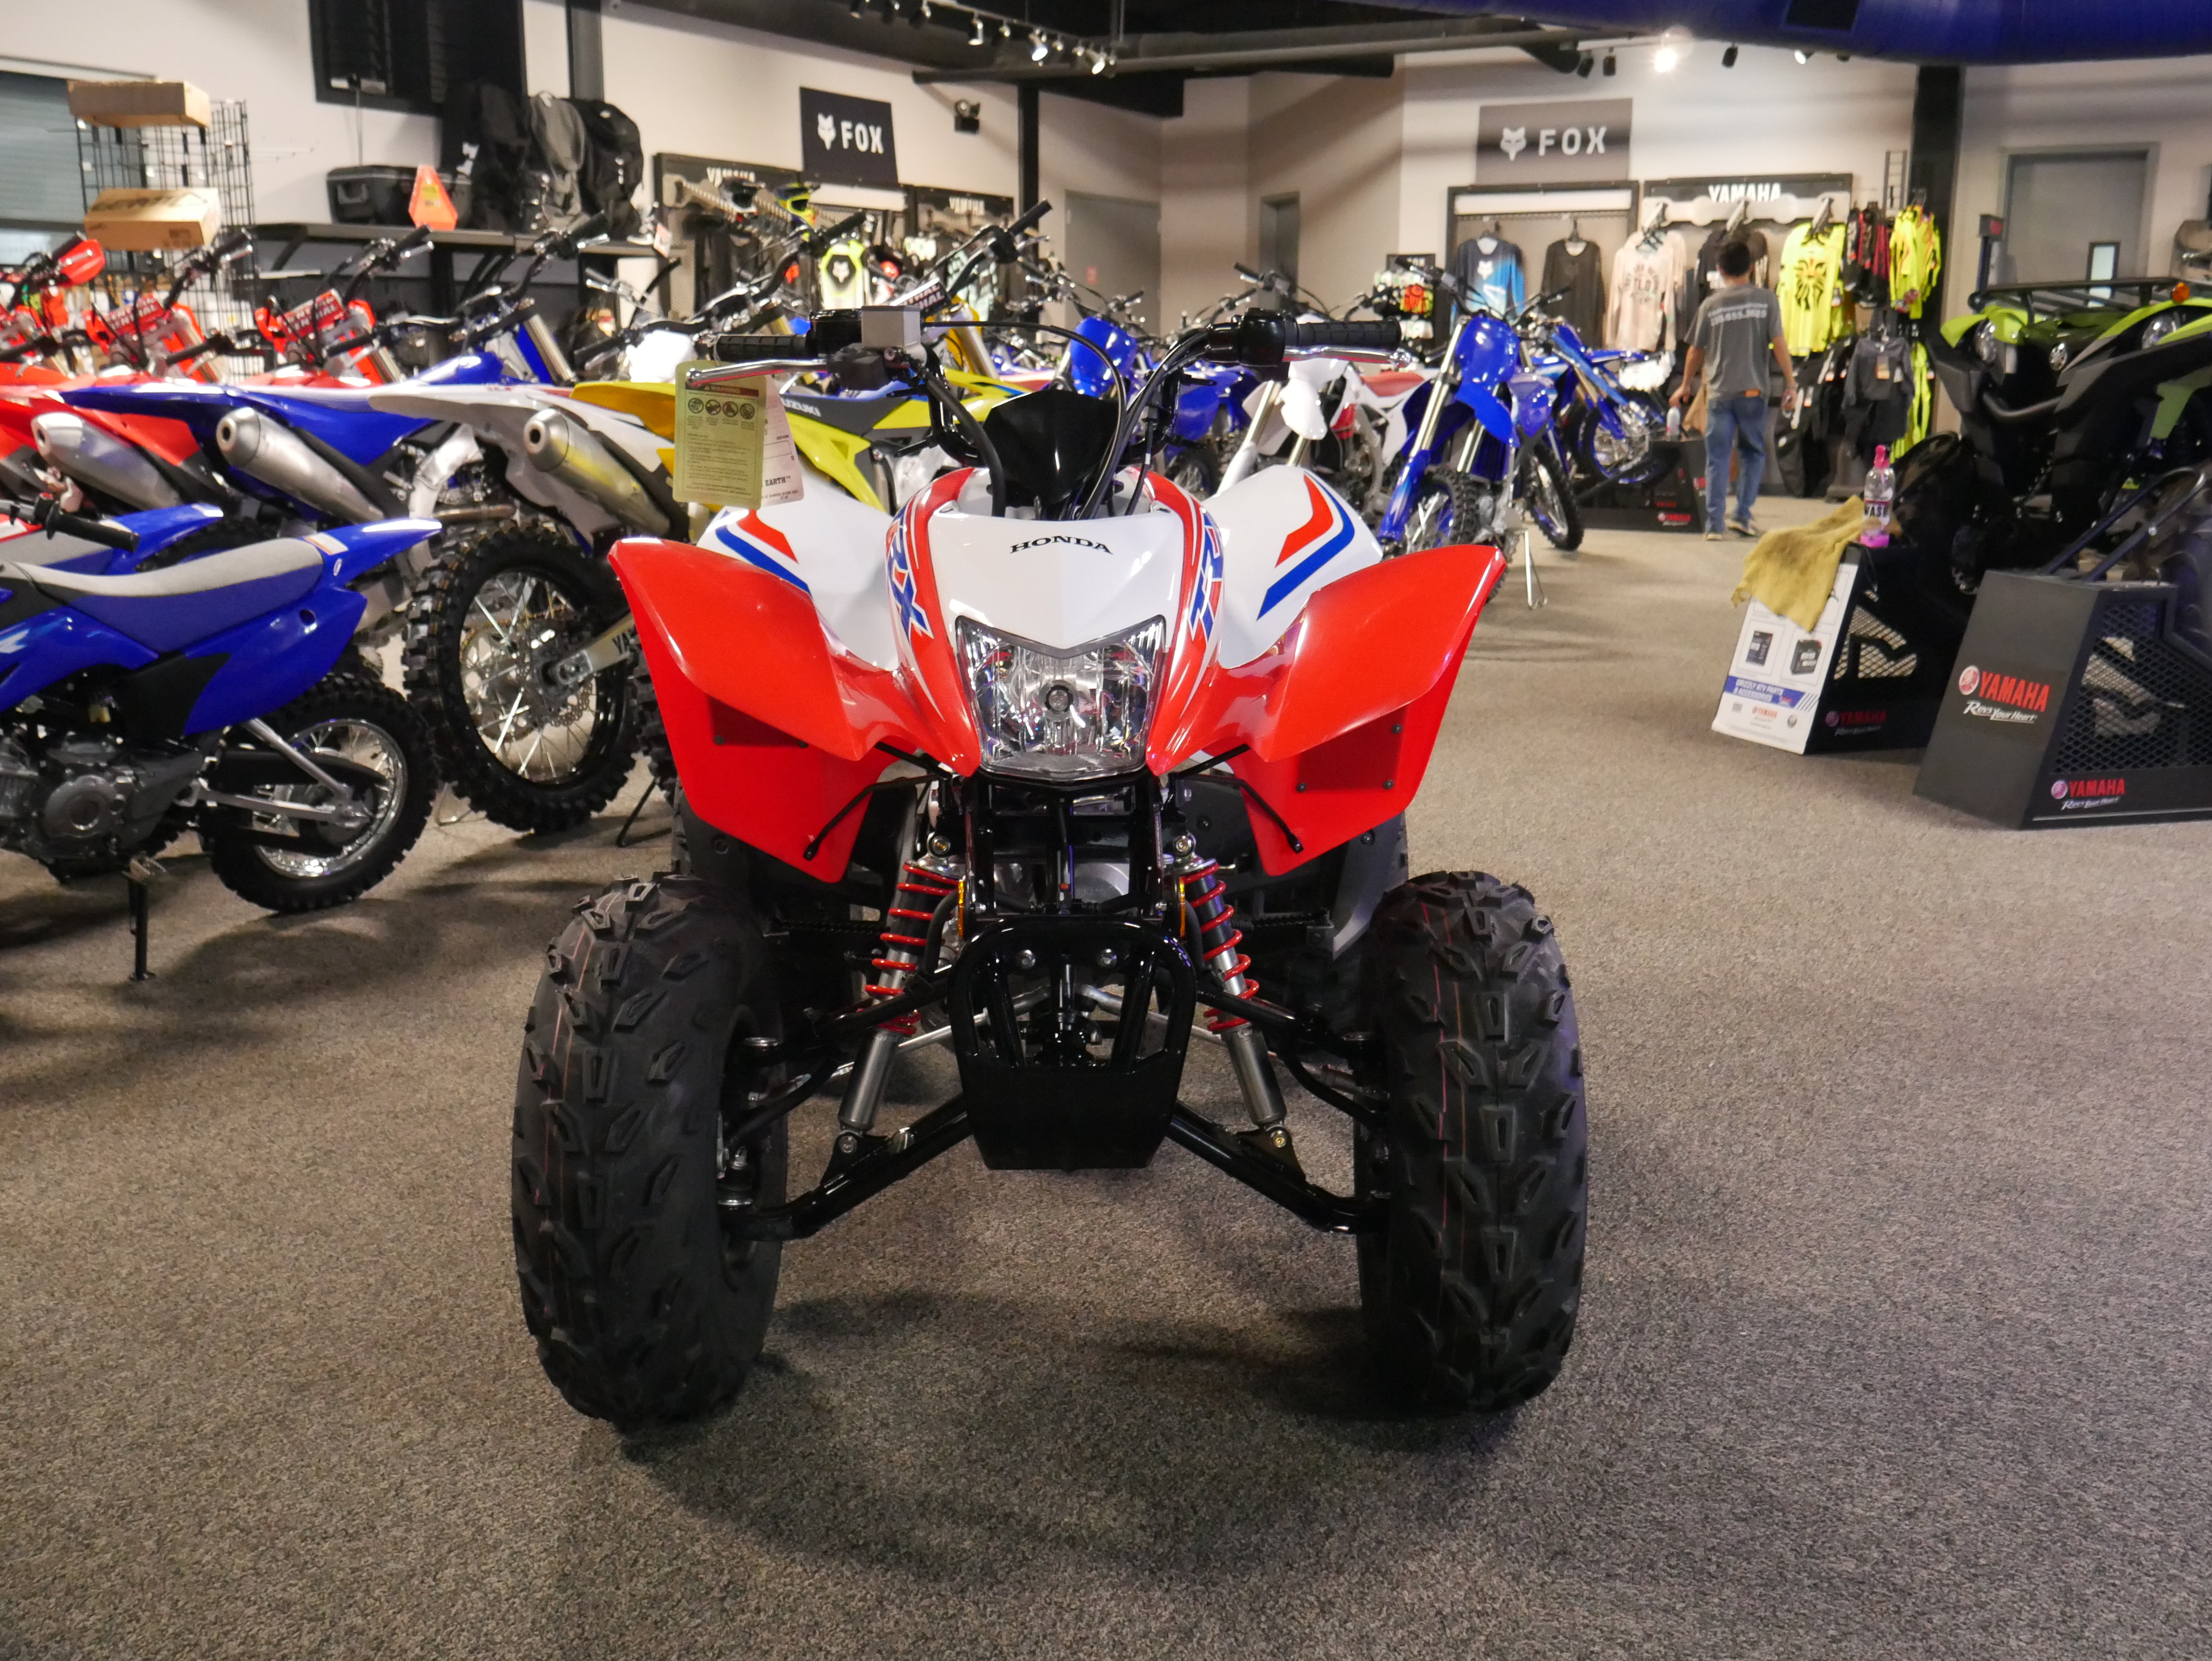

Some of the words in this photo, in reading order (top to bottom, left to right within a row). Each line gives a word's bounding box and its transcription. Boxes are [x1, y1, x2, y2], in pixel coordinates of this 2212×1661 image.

[841, 121, 884, 154] FOX
[1538, 126, 1607, 157] FOX
[1708, 182, 1781, 203] YAMAHA
[780, 397, 822, 418] UZUKI
[1010, 535, 1113, 555] HONDA
[1979, 671, 2050, 712] YAMAHA
[2069, 778, 2125, 797] YAMAHA
